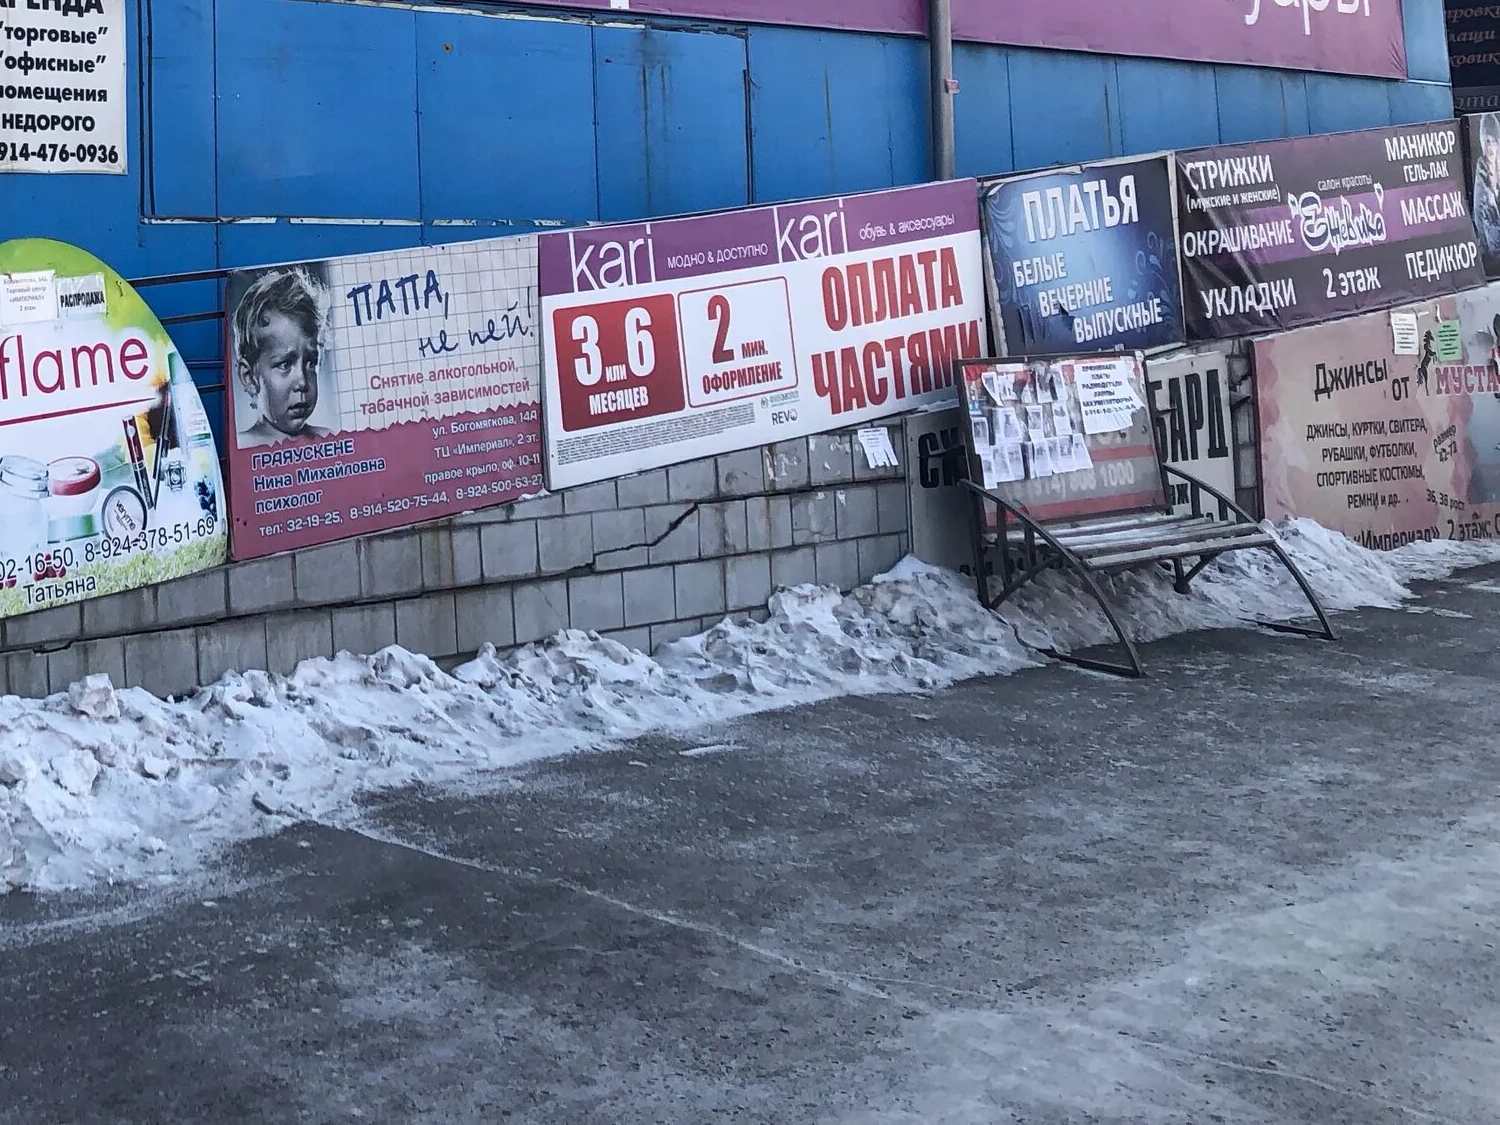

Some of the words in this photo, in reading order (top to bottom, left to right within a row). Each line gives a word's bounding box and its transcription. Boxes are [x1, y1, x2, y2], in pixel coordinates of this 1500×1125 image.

[2, 113, 95, 132] НЕДОРОГО
[1385, 130, 1455, 162] МАНИКЮР
[1186, 155, 1274, 191] СТРИЖКИ
[1318, 178, 1340, 191] салон
[1341, 175, 1373, 190] красоты
[1403, 160, 1449, 183] ГЕЛЬ-ЛАК
[1022, 175, 1139, 243] ПЛАТЬЯ
[1232, 194, 1240, 205] и
[1240, 184, 1281, 204] женские)
[1400, 191, 1465, 226] МАССАЖ
[773, 199, 848, 263] kari
[859, 224, 887, 242] обувь
[889, 223, 897, 235] &
[898, 213, 955, 236] аксессуары
[1183, 219, 1295, 258] ОКРАШИВАНИЕ
[569, 224, 656, 292] kari
[667, 253, 704, 270] МОДНО
[707, 251, 714, 263] &
[717, 242, 769, 263] ДОСТУПНО
[1013, 253, 1067, 287] БЕЛЫЕ
[1405, 241, 1478, 282] ПЕДИКЮР
[347, 270, 450, 326] ПАПА,
[821, 247, 964, 332] ОПЛАТА
[1038, 277, 1113, 317] ВЕЧЕРНИЕ
[1323, 268, 1337, 298] 2
[1338, 266, 1381, 293] этаж
[60, 291, 104, 308] РАСПРОДАЖА
[1200, 278, 1297, 319] УКЛАДКИ
[707, 294, 735, 364] 2
[1074, 298, 1163, 344] ВЫПУСКНЫЕ
[419, 328, 459, 358] не
[571, 315, 602, 386] 3
[625, 307, 656, 377] 6
[370, 371, 424, 391] Снятие
[429, 357, 519, 382] алкогольной,
[702, 361, 783, 396] ОФОРМЛЕНИЕ
[360, 395, 430, 416] табачной
[434, 379, 530, 405] зависимостей
[589, 385, 650, 417] МЕСЯЦЕВ
[432, 428, 447, 439] ул.
[451, 416, 516, 434] Богомягкова,
[1306, 422, 1350, 441] ДЖИНСЫ,
[1352, 420, 1388, 436] КУРТКИ,
[1389, 418, 1428, 434] СВИТЕРА,
[1433, 425, 1456, 454] размер
[435, 446, 451, 458] ТЦ
[453, 439, 514, 454] «Империал»,
[517, 434, 524, 444] 2
[526, 434, 538, 442] эт.
[1322, 445, 1368, 462] РУБАШКИ,
[1370, 442, 1418, 459] ФУТБОЛКИ,
[253, 472, 293, 493] Нина
[297, 457, 386, 485] Михайловна
[425, 468, 463, 484] правое
[466, 463, 500, 477] крыло,
[502, 458, 516, 470] оф.
[519, 453, 540, 465] 10-11
[1317, 468, 1378, 487] СПОРТИВНЫЕ
[1380, 464, 1425, 482] КОСТЮМЫ,
[255, 490, 323, 515] психолог
[259, 522, 284, 538] тел:
[287, 511, 343, 532] 32-19-25,
[349, 492, 451, 519] 8-914-520-75-44,
[456, 474, 543, 499] 8-924-500-63-27
[1348, 494, 1379, 510] РЕМНИ
[1426, 488, 1438, 505] 36,
[1439, 492, 1448, 506] 38
[1450, 499, 1465, 510] рост
[23, 575, 97, 606] Татьяна
